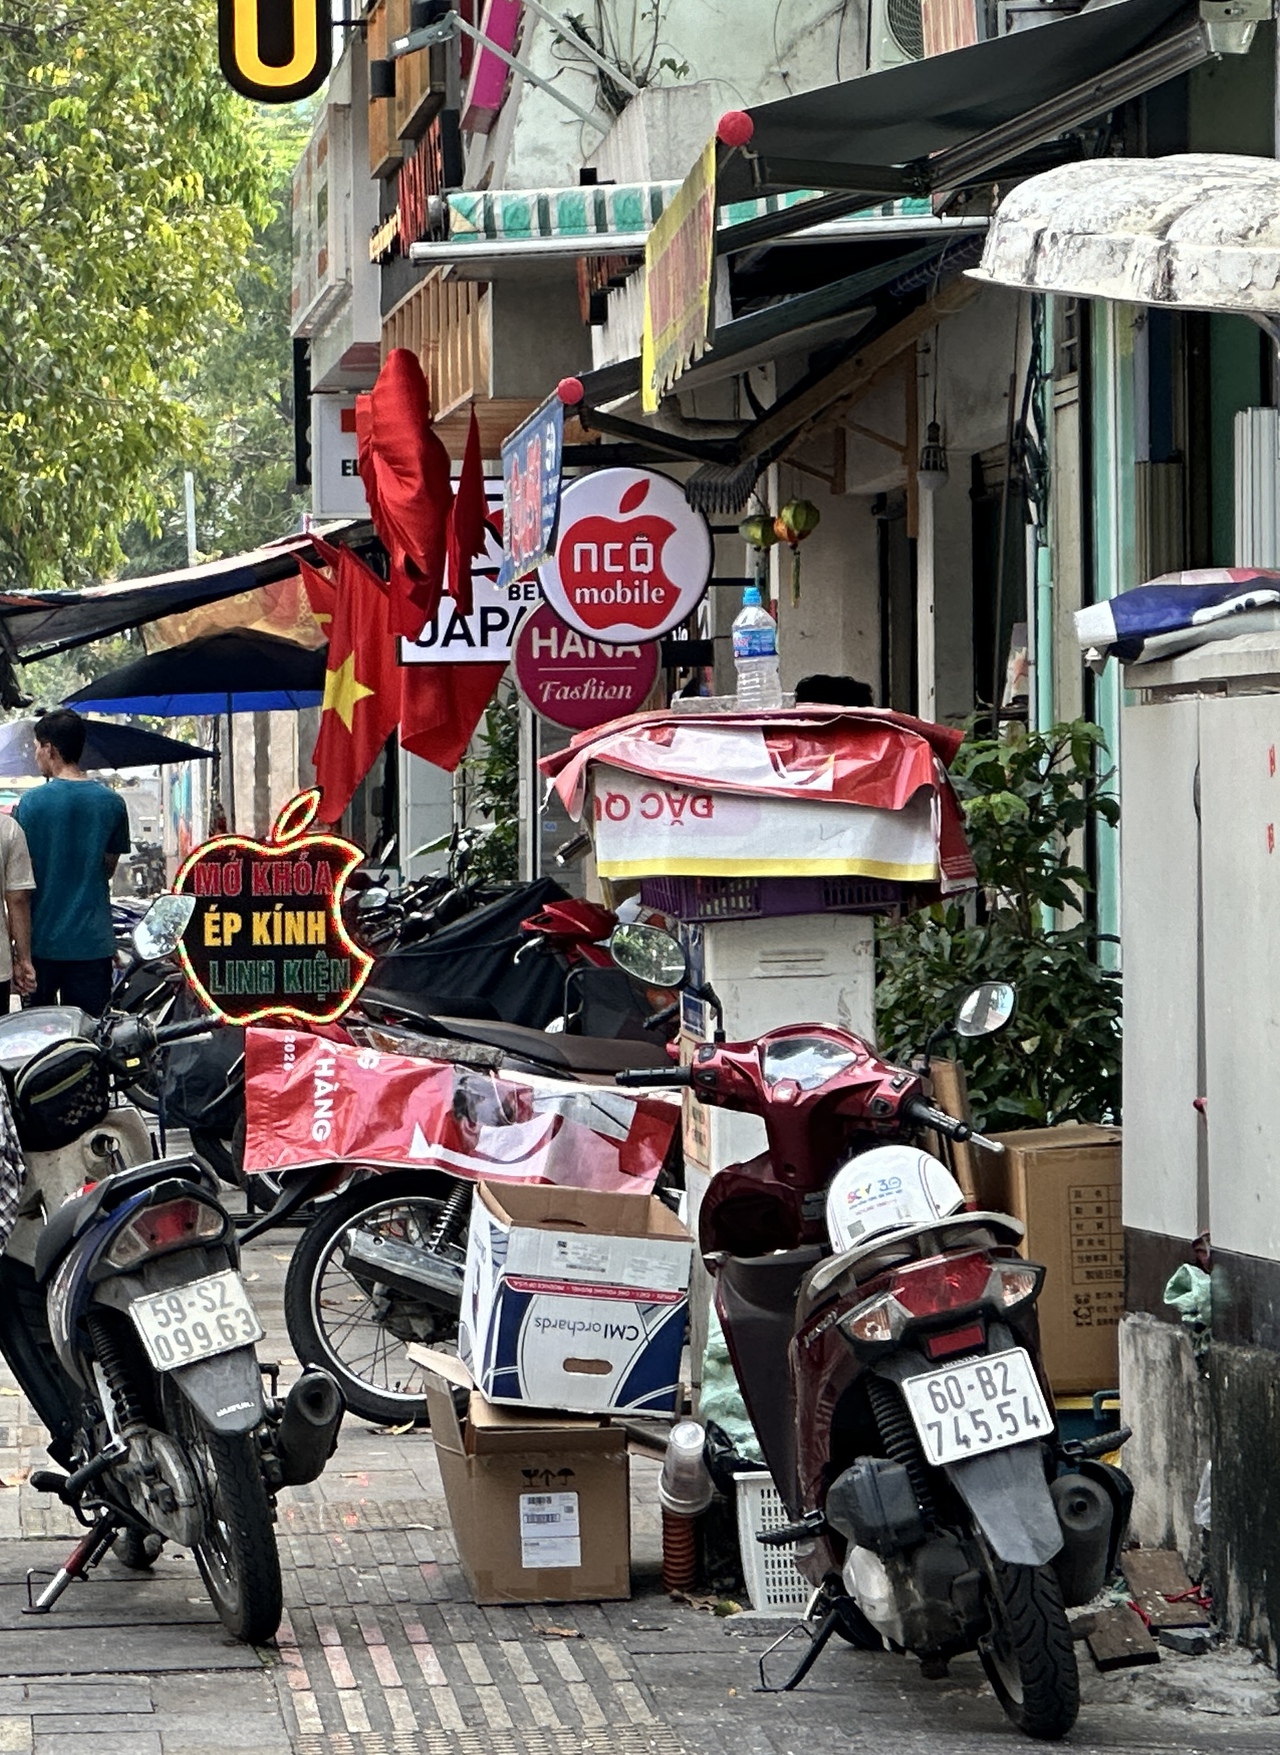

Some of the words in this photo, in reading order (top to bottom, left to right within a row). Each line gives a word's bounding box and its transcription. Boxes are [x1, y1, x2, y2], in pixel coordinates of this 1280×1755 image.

[575, 580, 666, 605] mobile
[538, 677, 633, 703] Fashion
[640, 784, 715, 827] ĐẶC
[194, 850, 244, 897] MỞ
[251, 851, 334, 897] KHÓA
[203, 904, 242, 947] ÉP
[251, 903, 327, 946] KÍNH
[209, 960, 276, 995] LINH
[283, 949, 351, 1002] KIỆN
[283, 1034, 297, 1072] 2026
[153, 1307, 257, 1363] 099.63
[534, 1317, 601, 1336] orchards
[926, 1396, 1041, 1457] 745.54
